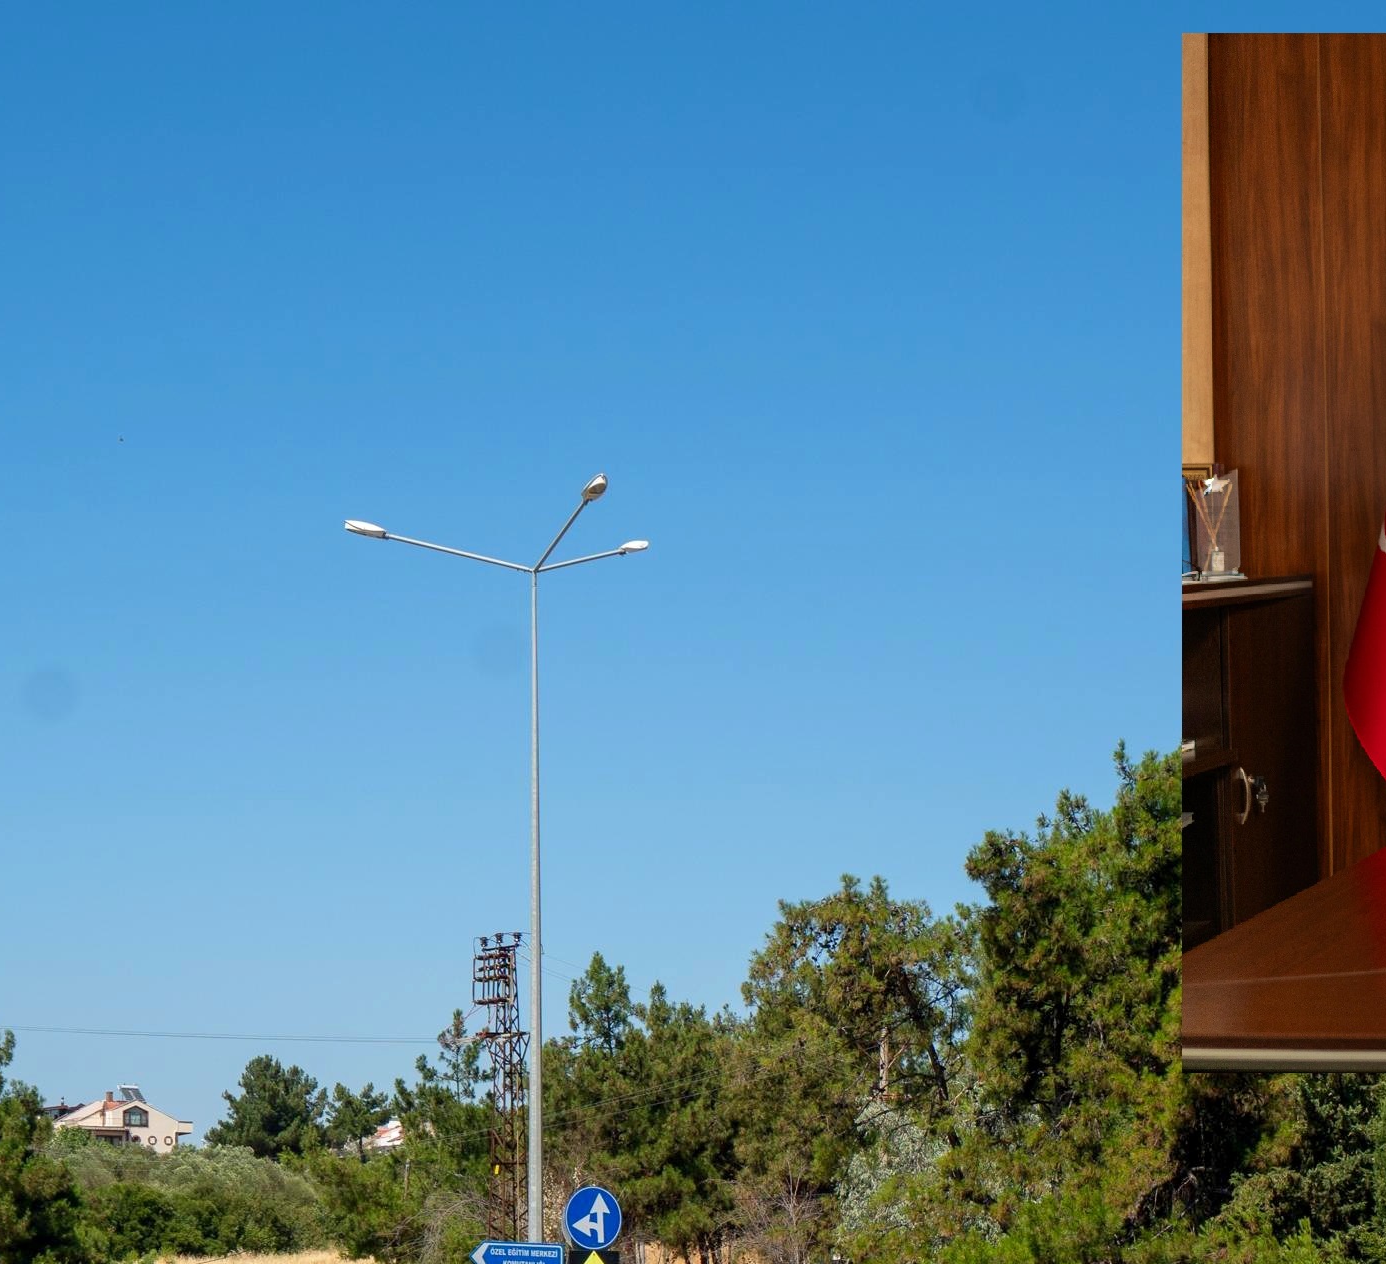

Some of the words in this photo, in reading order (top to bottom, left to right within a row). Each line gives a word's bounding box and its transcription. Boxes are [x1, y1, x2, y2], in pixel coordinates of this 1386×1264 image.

[490, 1247, 506, 1256] ÖZEL
[508, 1248, 530, 1257] EĞİTİM
[531, 1249, 558, 1258] MERKEZİ
